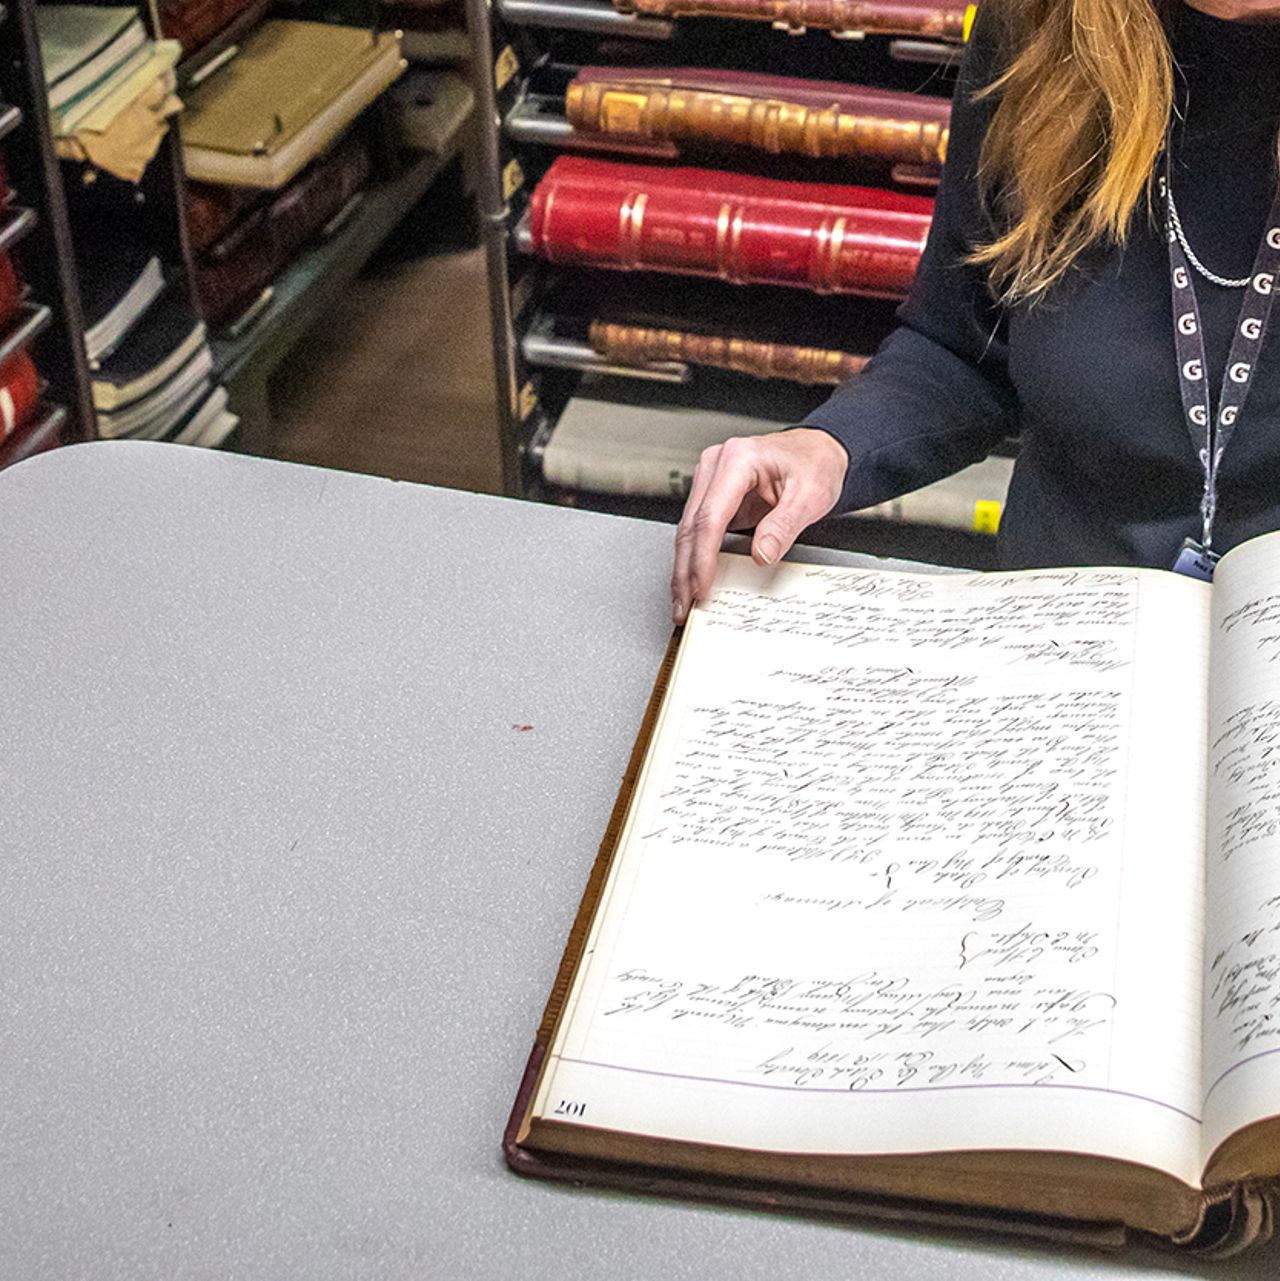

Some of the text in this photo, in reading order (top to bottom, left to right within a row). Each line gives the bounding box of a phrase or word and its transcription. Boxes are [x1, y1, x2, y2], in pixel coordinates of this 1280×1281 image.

[1173, 266, 1188, 289] G
[1252, 272, 1274, 295] G
[1177, 312, 1197, 335] G
[1240, 317, 1262, 340] G
[1182, 359, 1203, 381] G
[1229, 362, 1251, 383] G
[1188, 404, 1208, 426] G
[1219, 405, 1239, 426] G
[553, 1100, 587, 1117] 107
